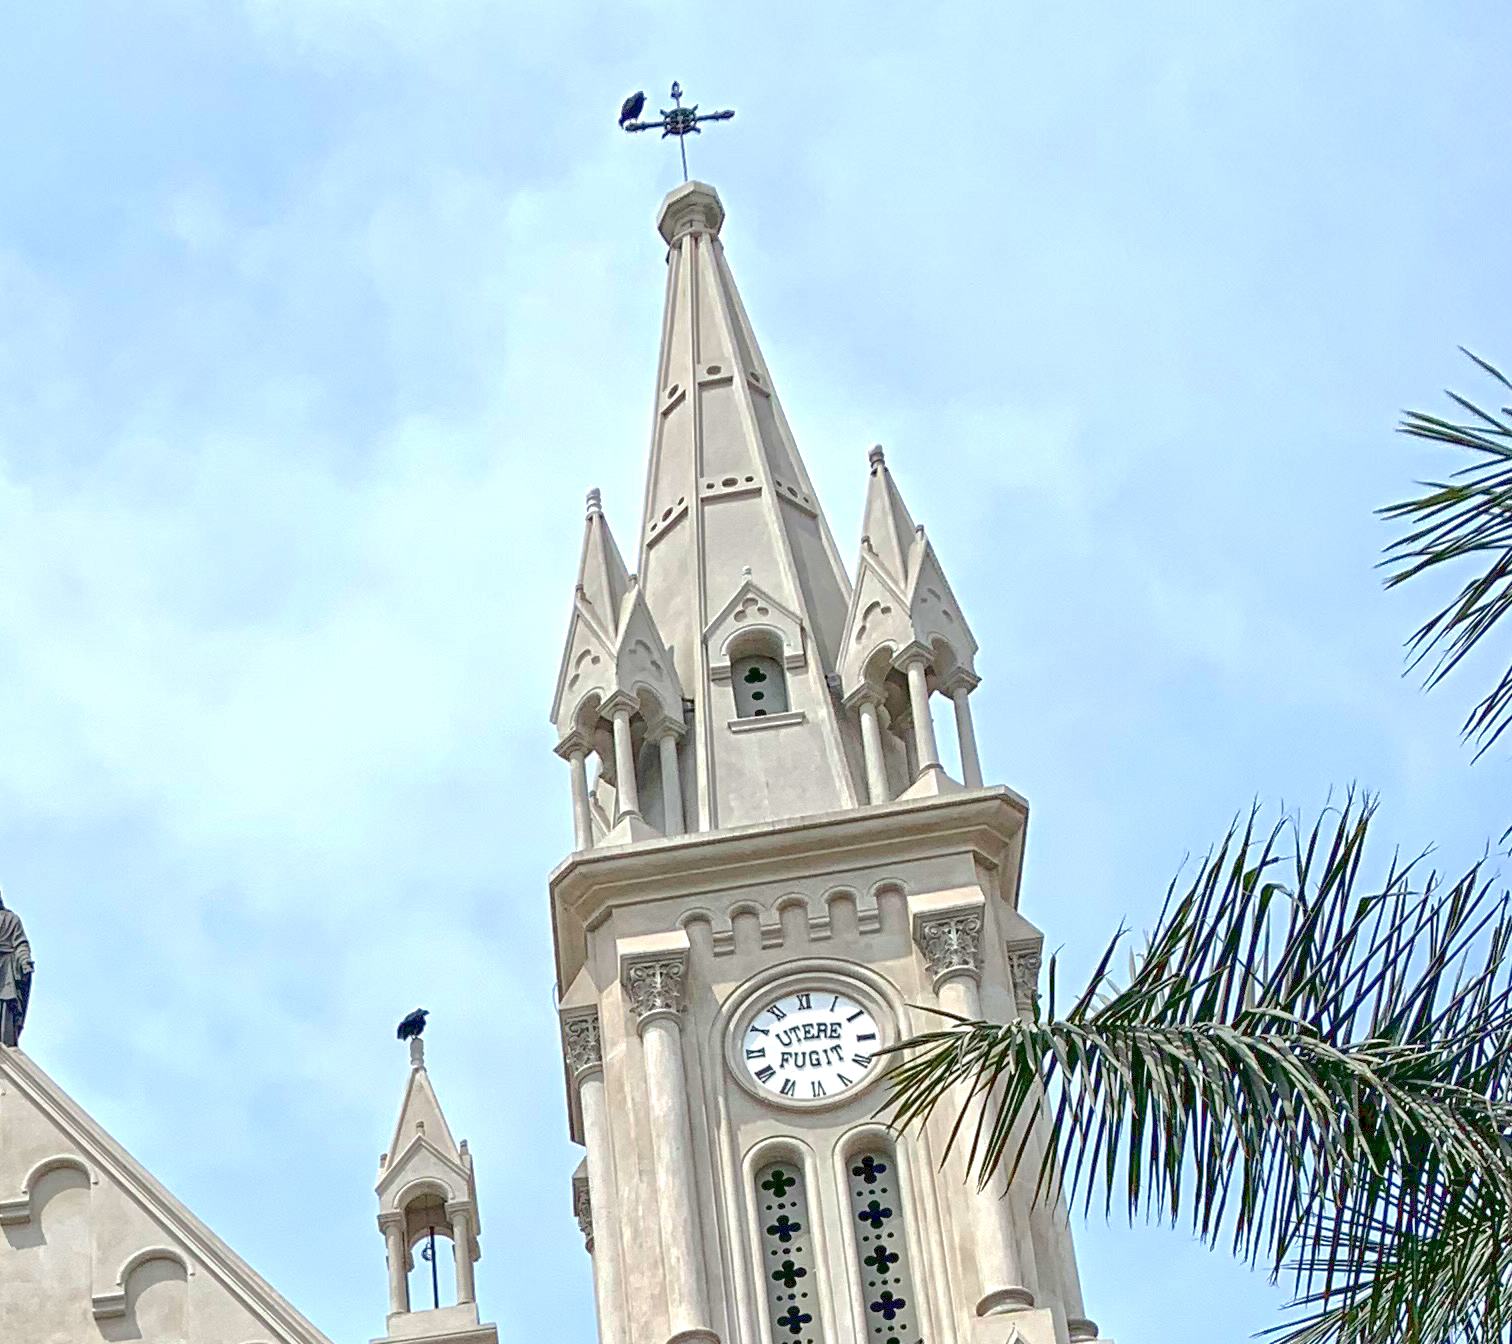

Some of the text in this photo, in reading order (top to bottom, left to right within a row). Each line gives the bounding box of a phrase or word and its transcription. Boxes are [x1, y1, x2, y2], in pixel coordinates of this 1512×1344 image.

[797, 993, 812, 1011] XII
[830, 996, 838, 1012] I
[767, 1004, 787, 1021] XI
[750, 1025, 769, 1036] X
[775, 1022, 842, 1047] UTERE
[746, 1047, 766, 1060] IX
[780, 1044, 844, 1068] FUGIT
[811, 1080, 826, 1097] VI
[837, 1073, 853, 1087] V
